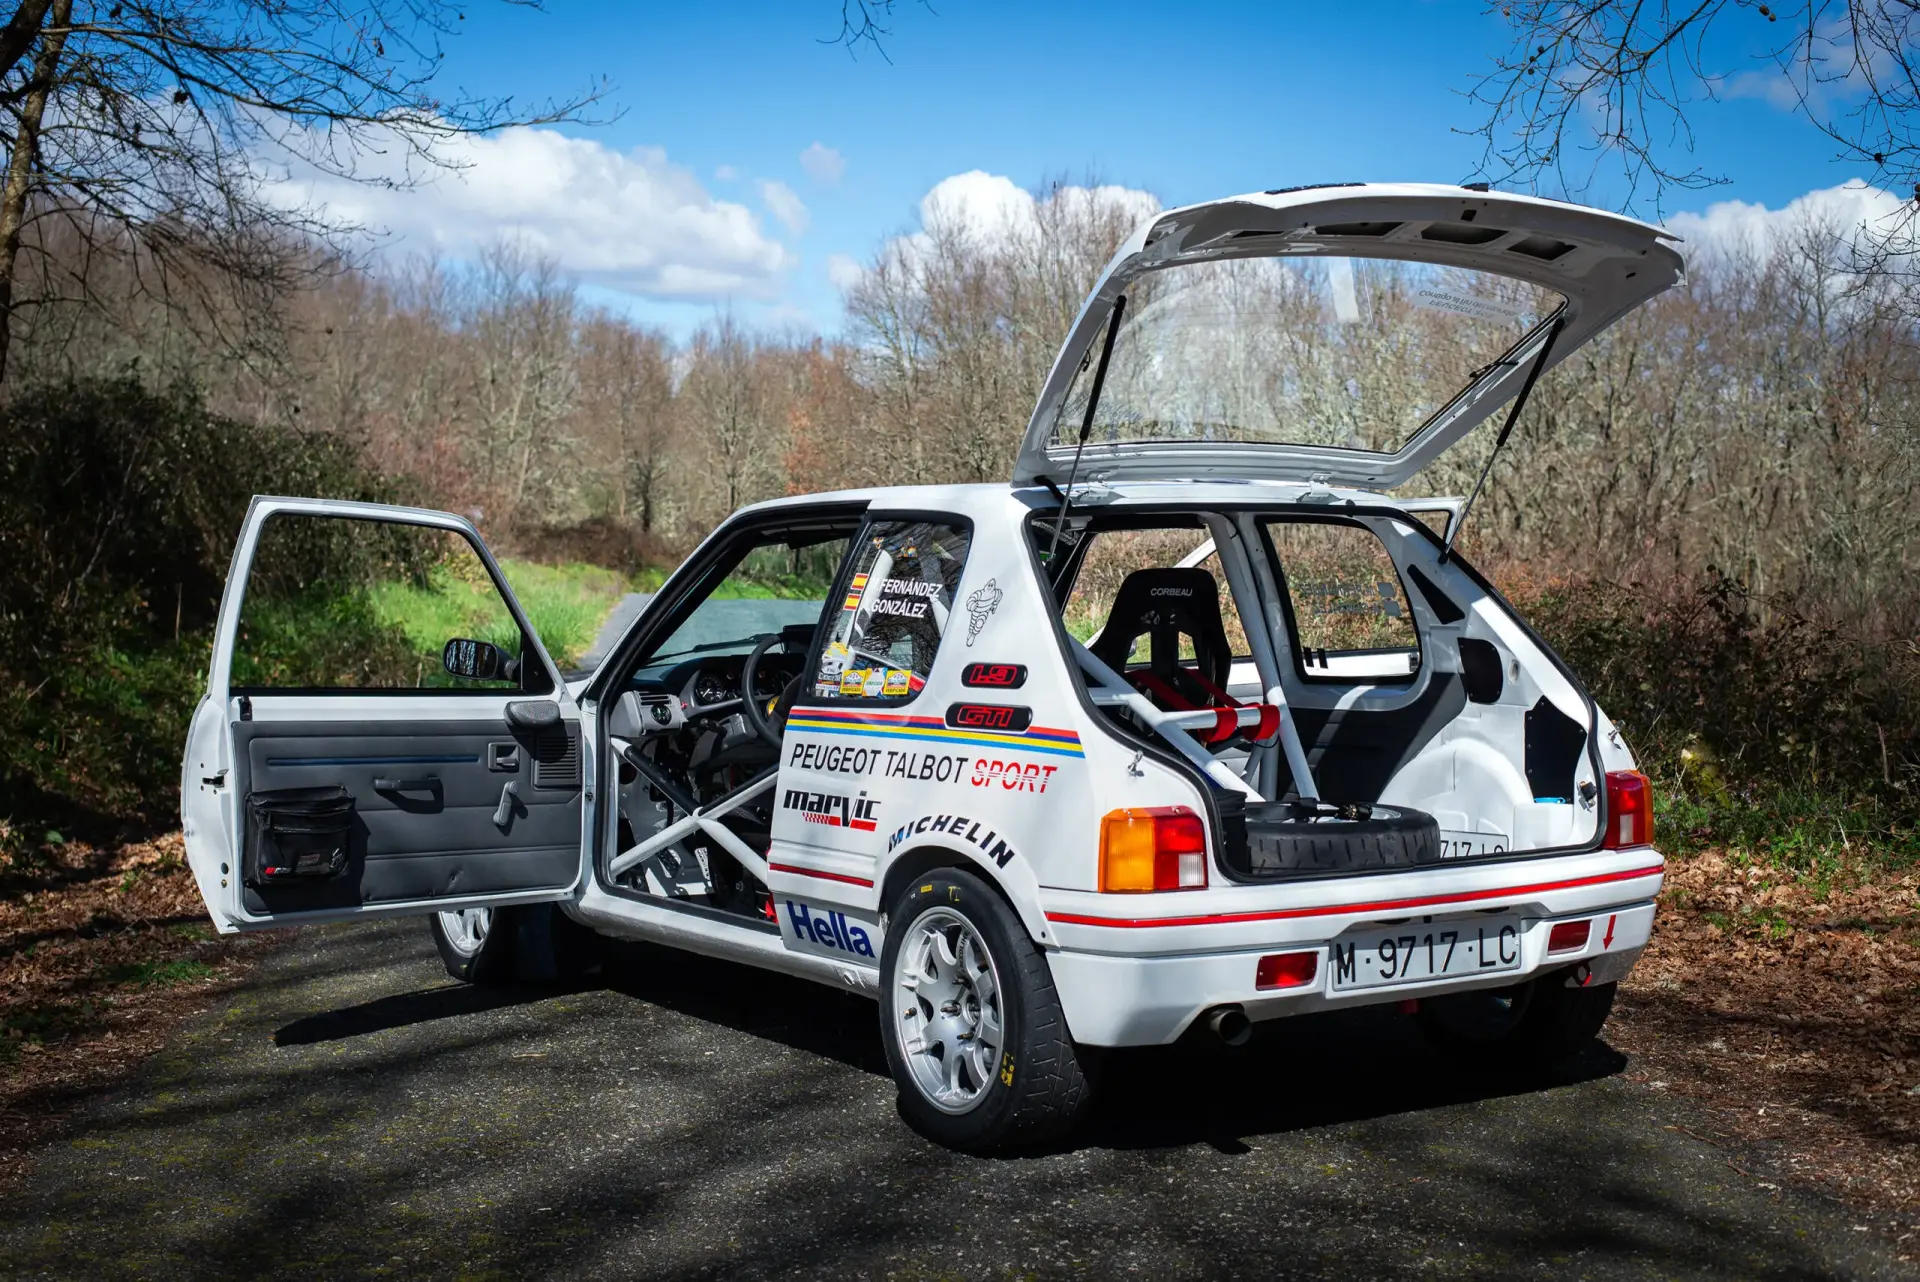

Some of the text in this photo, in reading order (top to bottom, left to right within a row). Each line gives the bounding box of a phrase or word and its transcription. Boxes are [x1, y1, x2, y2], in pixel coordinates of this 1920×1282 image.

[1150, 587, 1193, 597] CORBEAU
[790, 743, 1058, 793] PEUGEOT TALBOT SPORT
[888, 814, 1015, 870] MICHELIN
[786, 900, 876, 959] Hella
